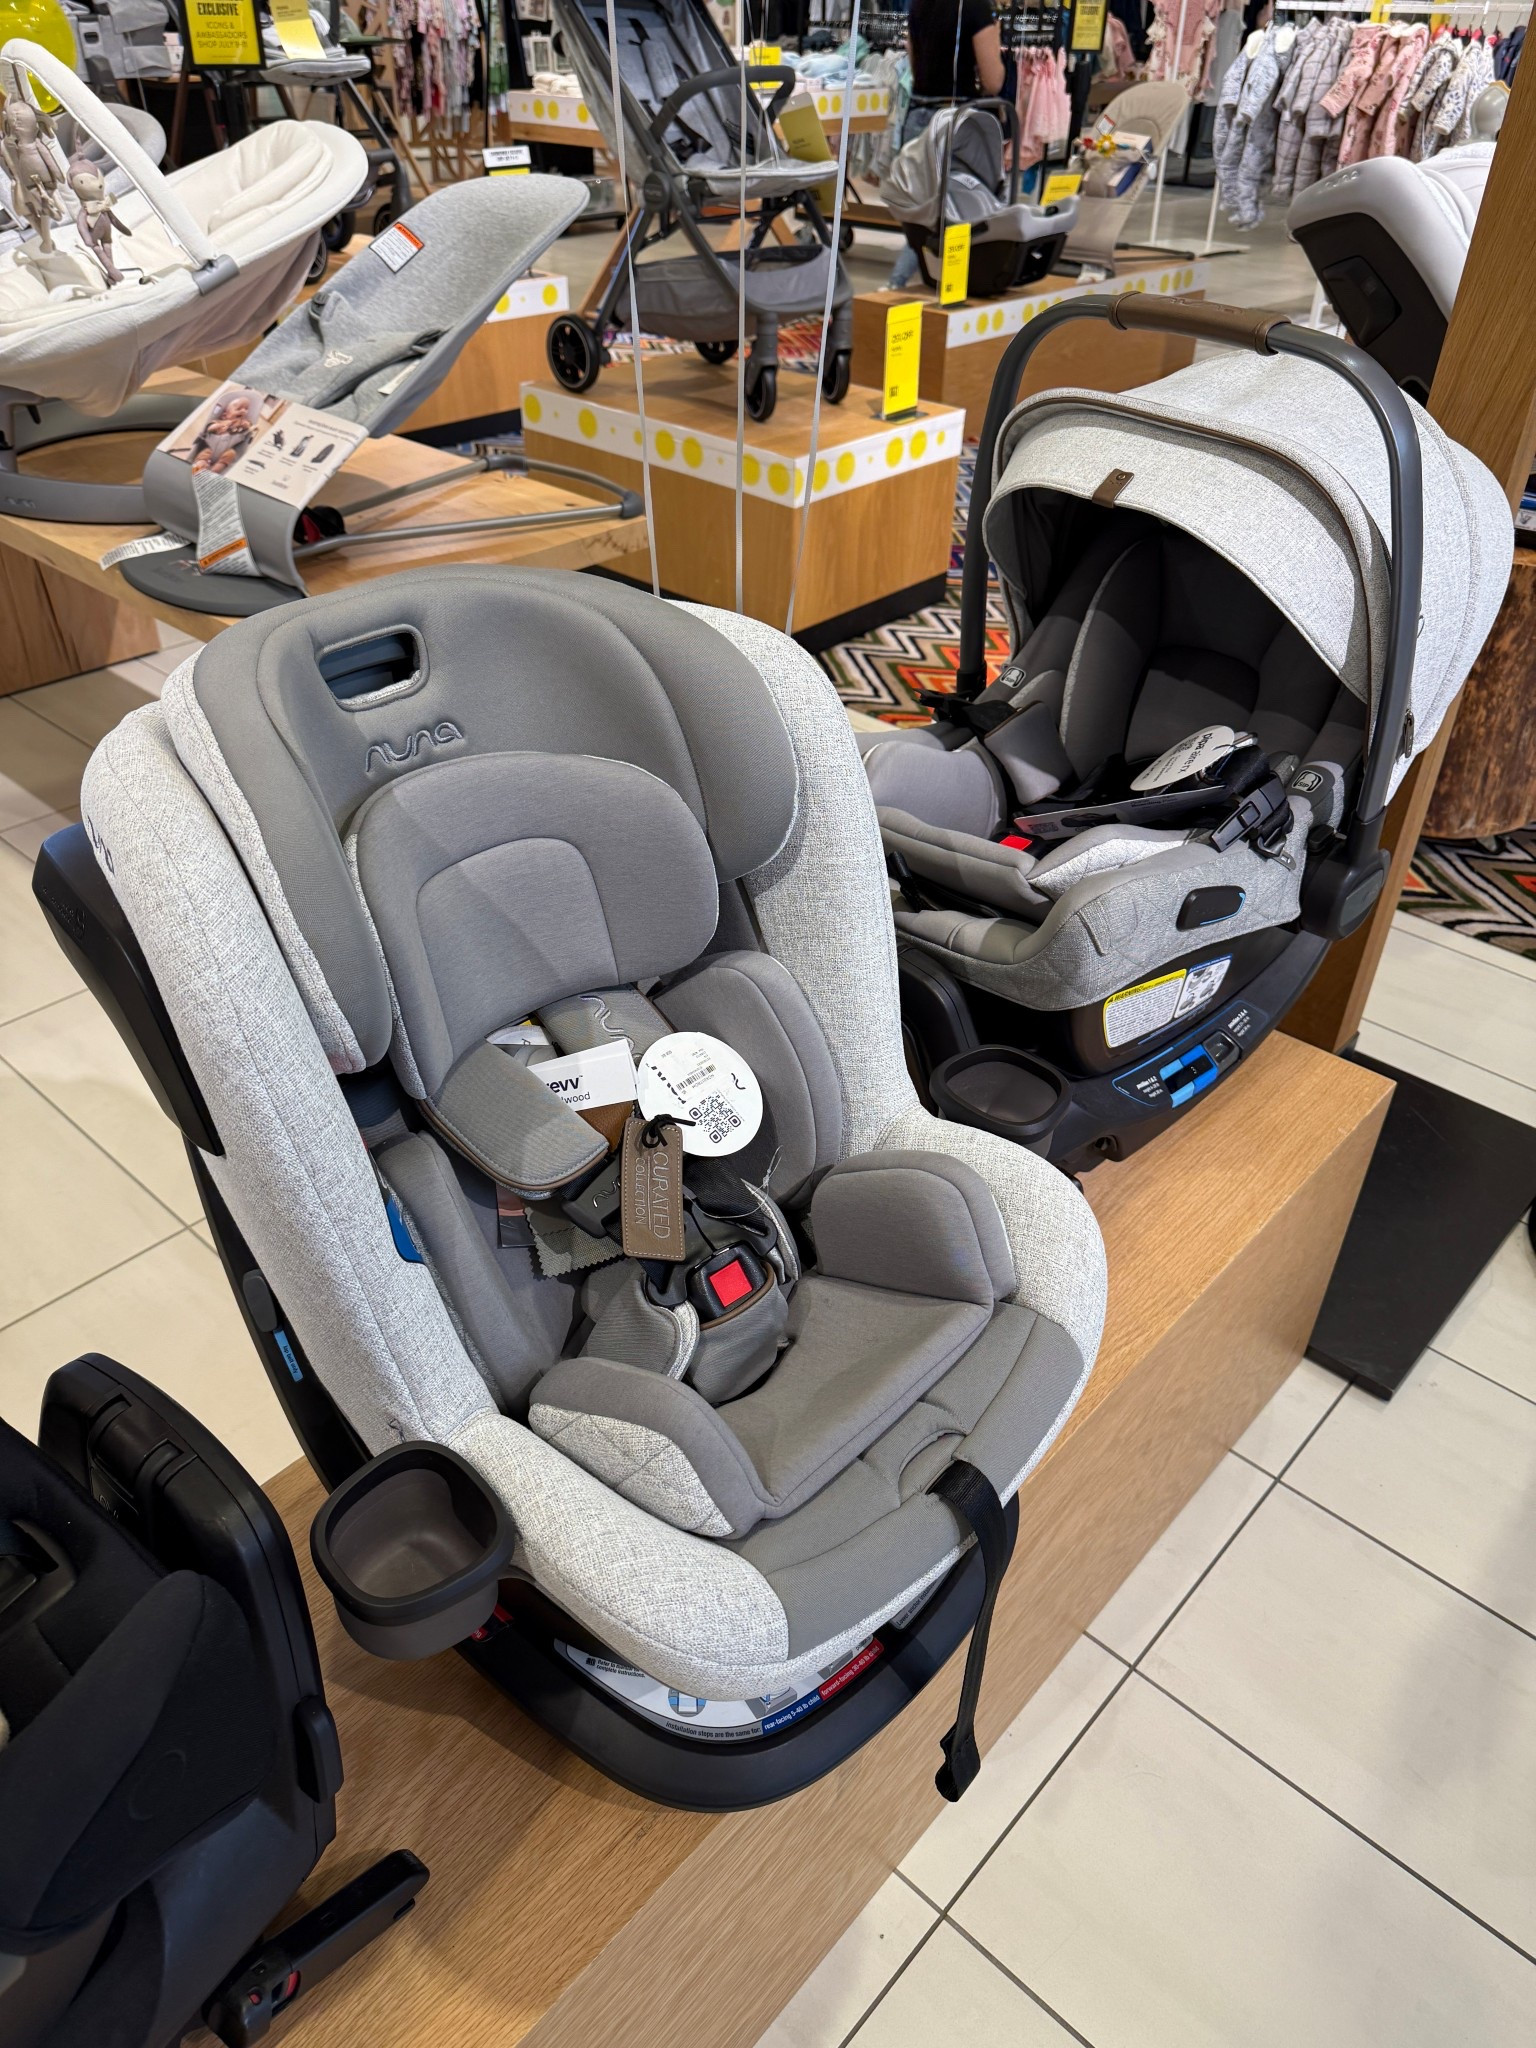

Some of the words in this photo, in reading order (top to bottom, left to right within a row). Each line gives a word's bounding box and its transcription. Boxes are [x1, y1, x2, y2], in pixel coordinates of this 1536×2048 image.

[197, 3, 239, 16] EXCLUSIVE
[196, 31, 248, 39] AMBASSADORS
[366, 722, 463, 772] nuna
[634, 1157, 647, 1225] COLLECTION
[652, 1151, 671, 1239] CURATED
[897, 1612, 909, 1626] Lower
[597, 1665, 618, 1674] complete
[617, 1668, 646, 1678] instructions.
[821, 1668, 855, 1696] forward-facing
[851, 1657, 866, 1672] 30-40
[868, 1645, 880, 1659] child
[698, 1729, 714, 1738] steps
[725, 1730, 735, 1738] the
[764, 1712, 793, 1731] rear-facing
[802, 1702, 809, 1710] lb
[807, 1694, 821, 1707] child
